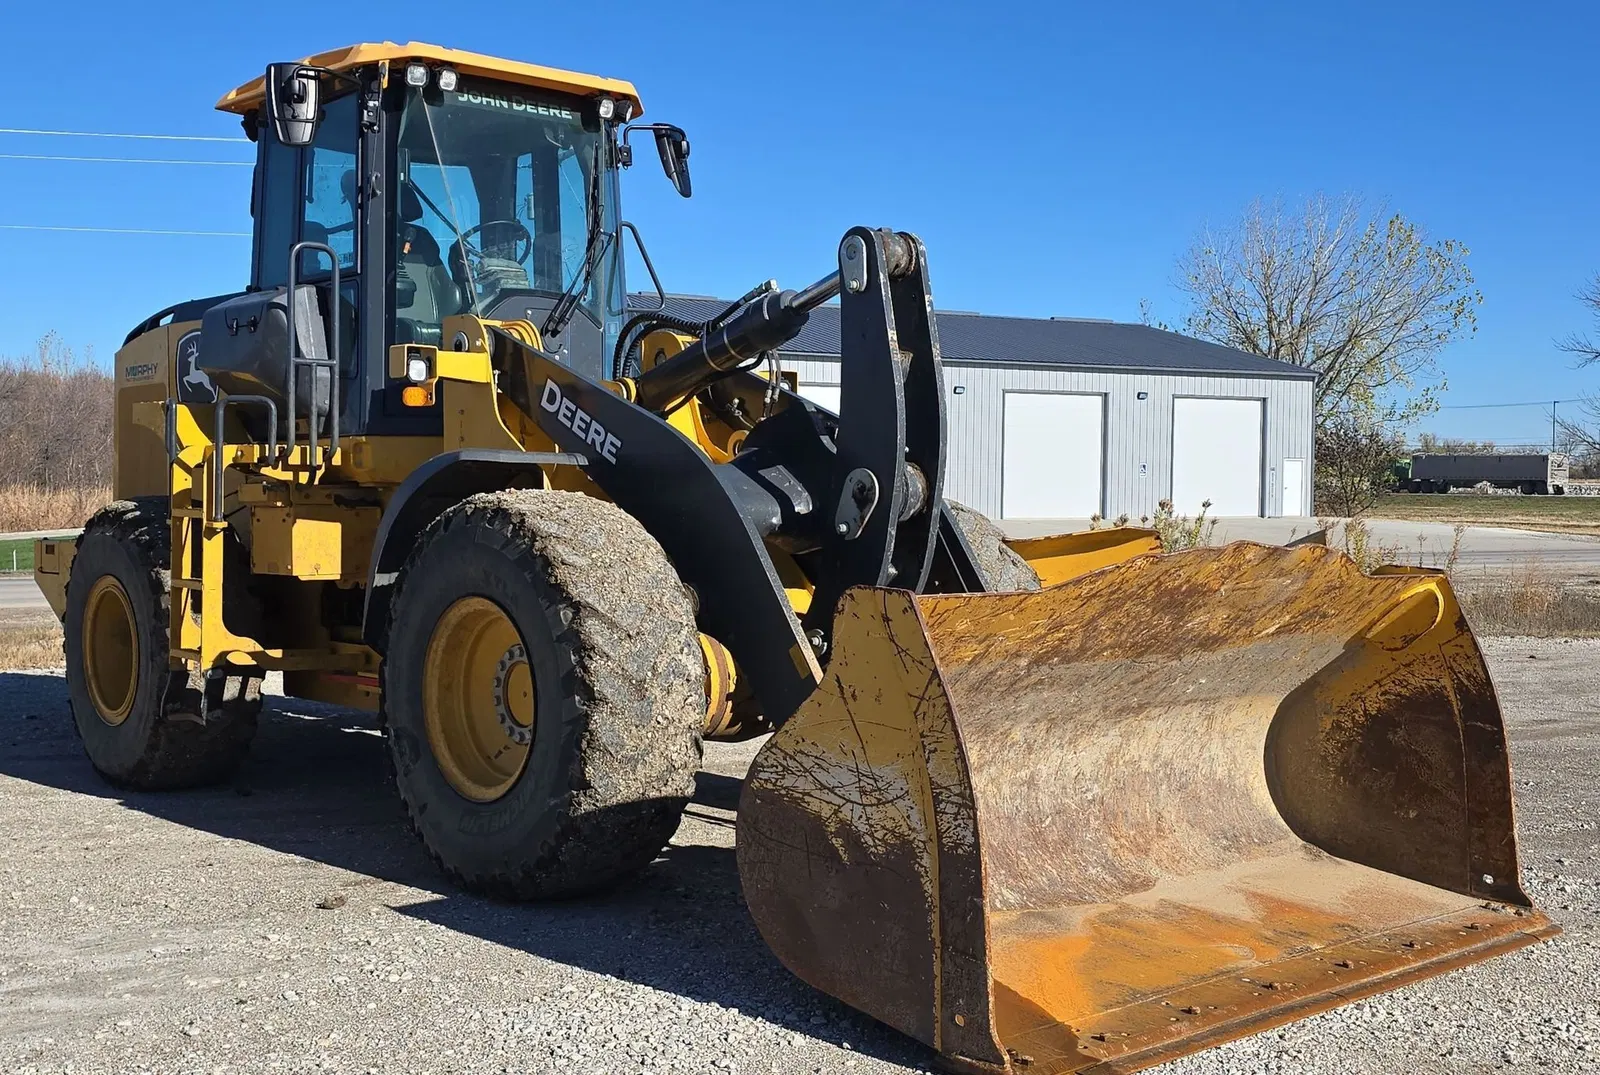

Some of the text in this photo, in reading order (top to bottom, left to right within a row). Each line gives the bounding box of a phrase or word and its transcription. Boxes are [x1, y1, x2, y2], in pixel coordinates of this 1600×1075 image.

[458, 88, 573, 120] JOHN DEERE
[125, 362, 159, 378] MURPHY
[540, 378, 622, 465] DEERE
